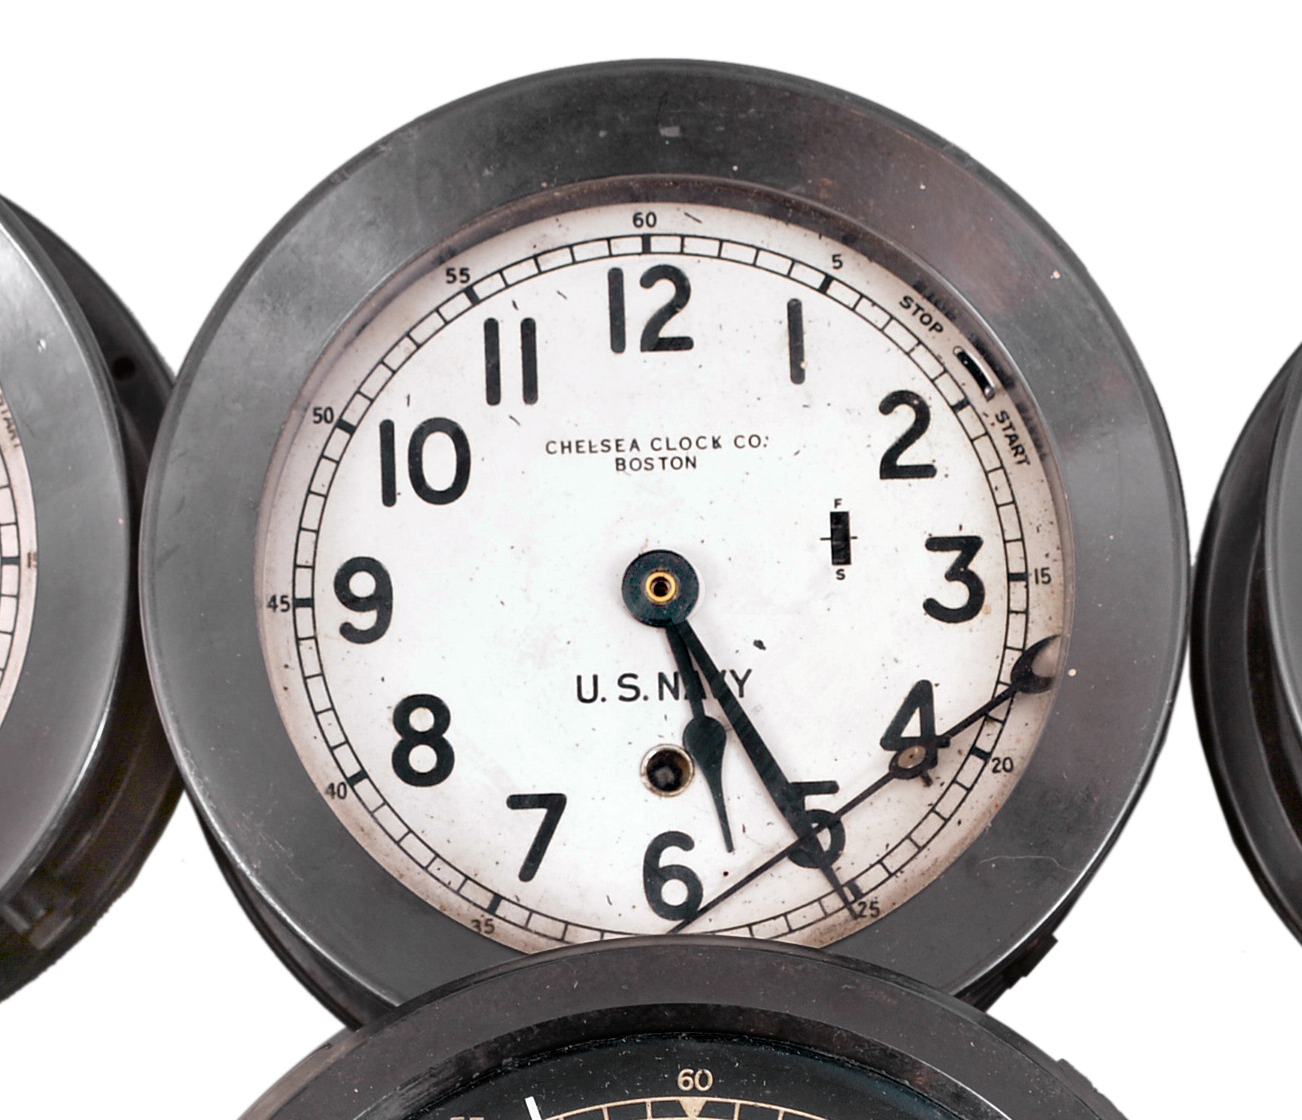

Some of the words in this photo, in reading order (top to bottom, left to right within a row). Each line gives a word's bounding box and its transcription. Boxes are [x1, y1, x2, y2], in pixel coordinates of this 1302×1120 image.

[632, 212, 657, 227] 60
[831, 254, 843, 269] 5
[446, 268, 470, 284] 55
[608, 264, 693, 354] 12
[899, 295, 944, 335] STOP
[312, 407, 334, 424] 50
[546, 439, 640, 456] CHELSEA
[650, 436, 722, 451] CLOCK
[996, 410, 1030, 467] START
[380, 417, 471, 507] 10
[616, 456, 697, 471] BOSTON
[835, 499, 843, 508] F
[836, 570, 846, 580] S
[923, 535, 985, 623] 3
[1034, 568, 1051, 584] 15
[267, 595, 291, 612] 45
[334, 556, 393, 644] 9
[658, 669, 751, 700] NY
[992, 757, 1014, 773] 20
[325, 782, 347, 800] 40
[643, 831, 703, 920] 6
[858, 902, 880, 917] 25
[471, 919, 495, 934] 35
[676, 1068, 714, 1092] 60
